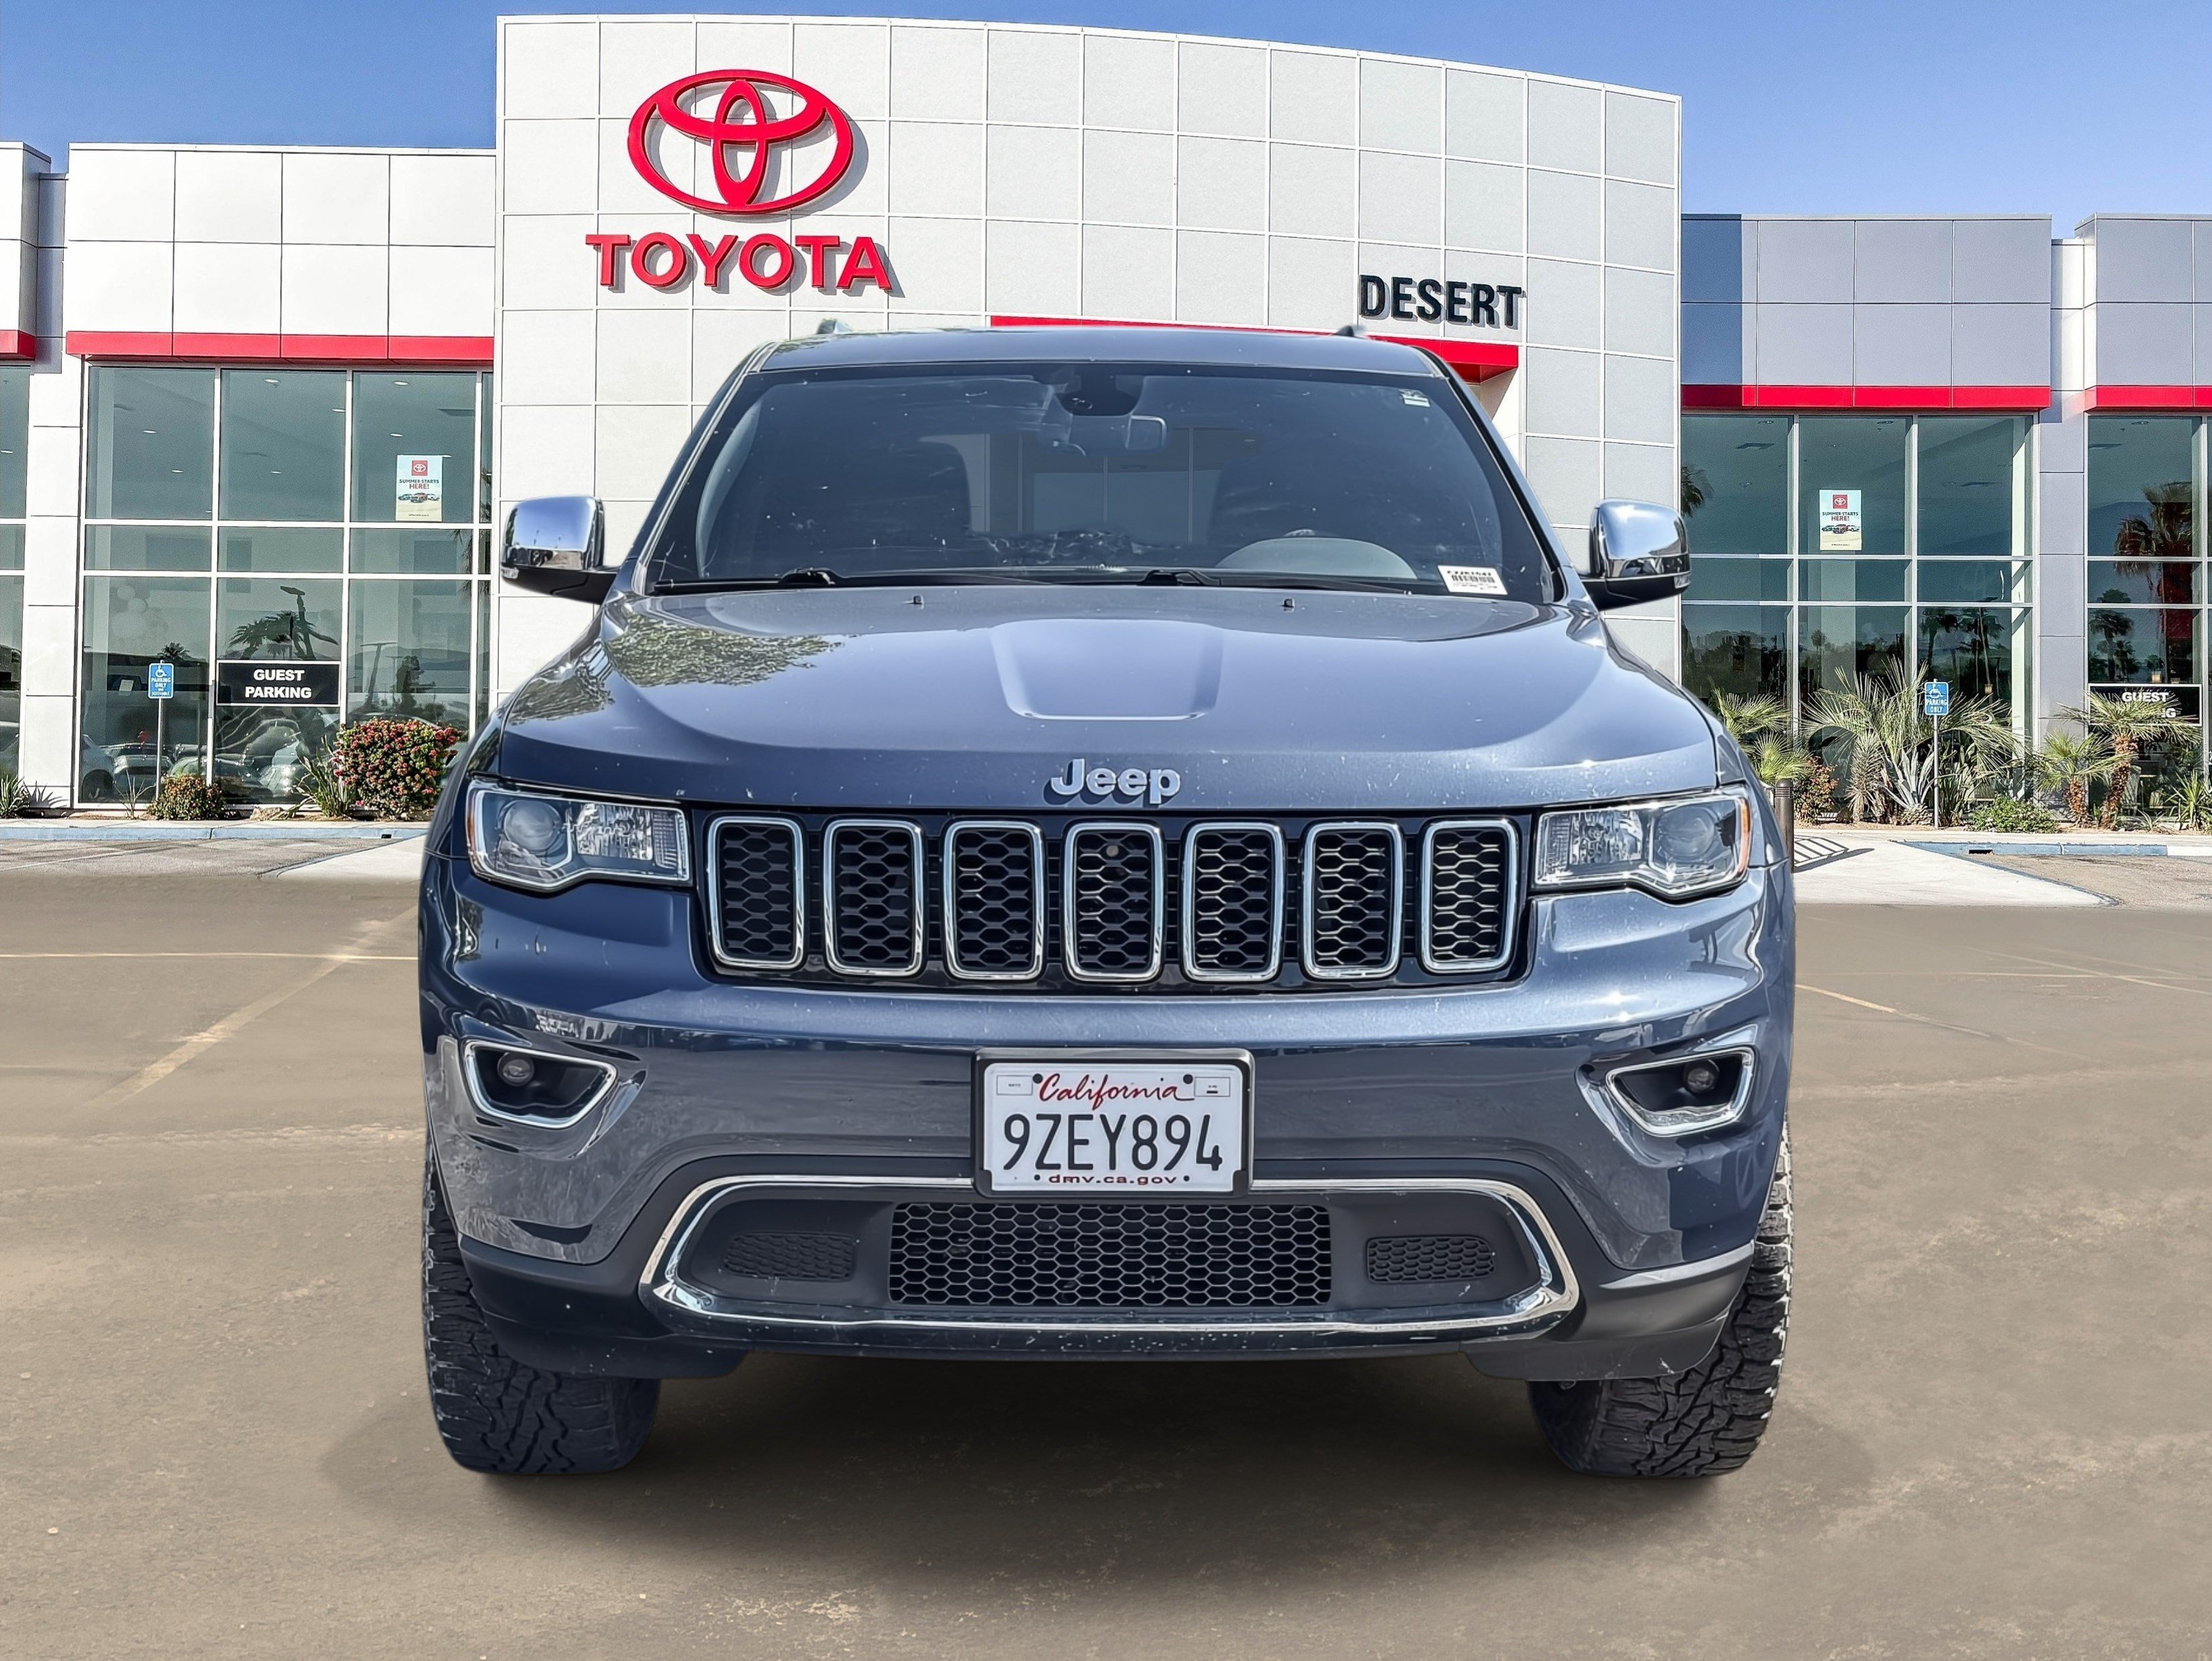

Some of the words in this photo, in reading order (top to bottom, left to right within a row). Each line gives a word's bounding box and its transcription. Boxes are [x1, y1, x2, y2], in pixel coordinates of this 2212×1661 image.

[585, 232, 892, 290] TOYOTA
[1359, 274, 1522, 327] DESERT
[245, 686, 312, 699] PARKING
[253, 669, 305, 681] GUEST
[2121, 691, 2169, 703] GUEST
[1050, 758, 1180, 805] Jeep
[1038, 1072, 1195, 1110] California
[1003, 1113, 1223, 1172] 9ZEY894
[1048, 1174, 1177, 1185] dmv.ca.gov
